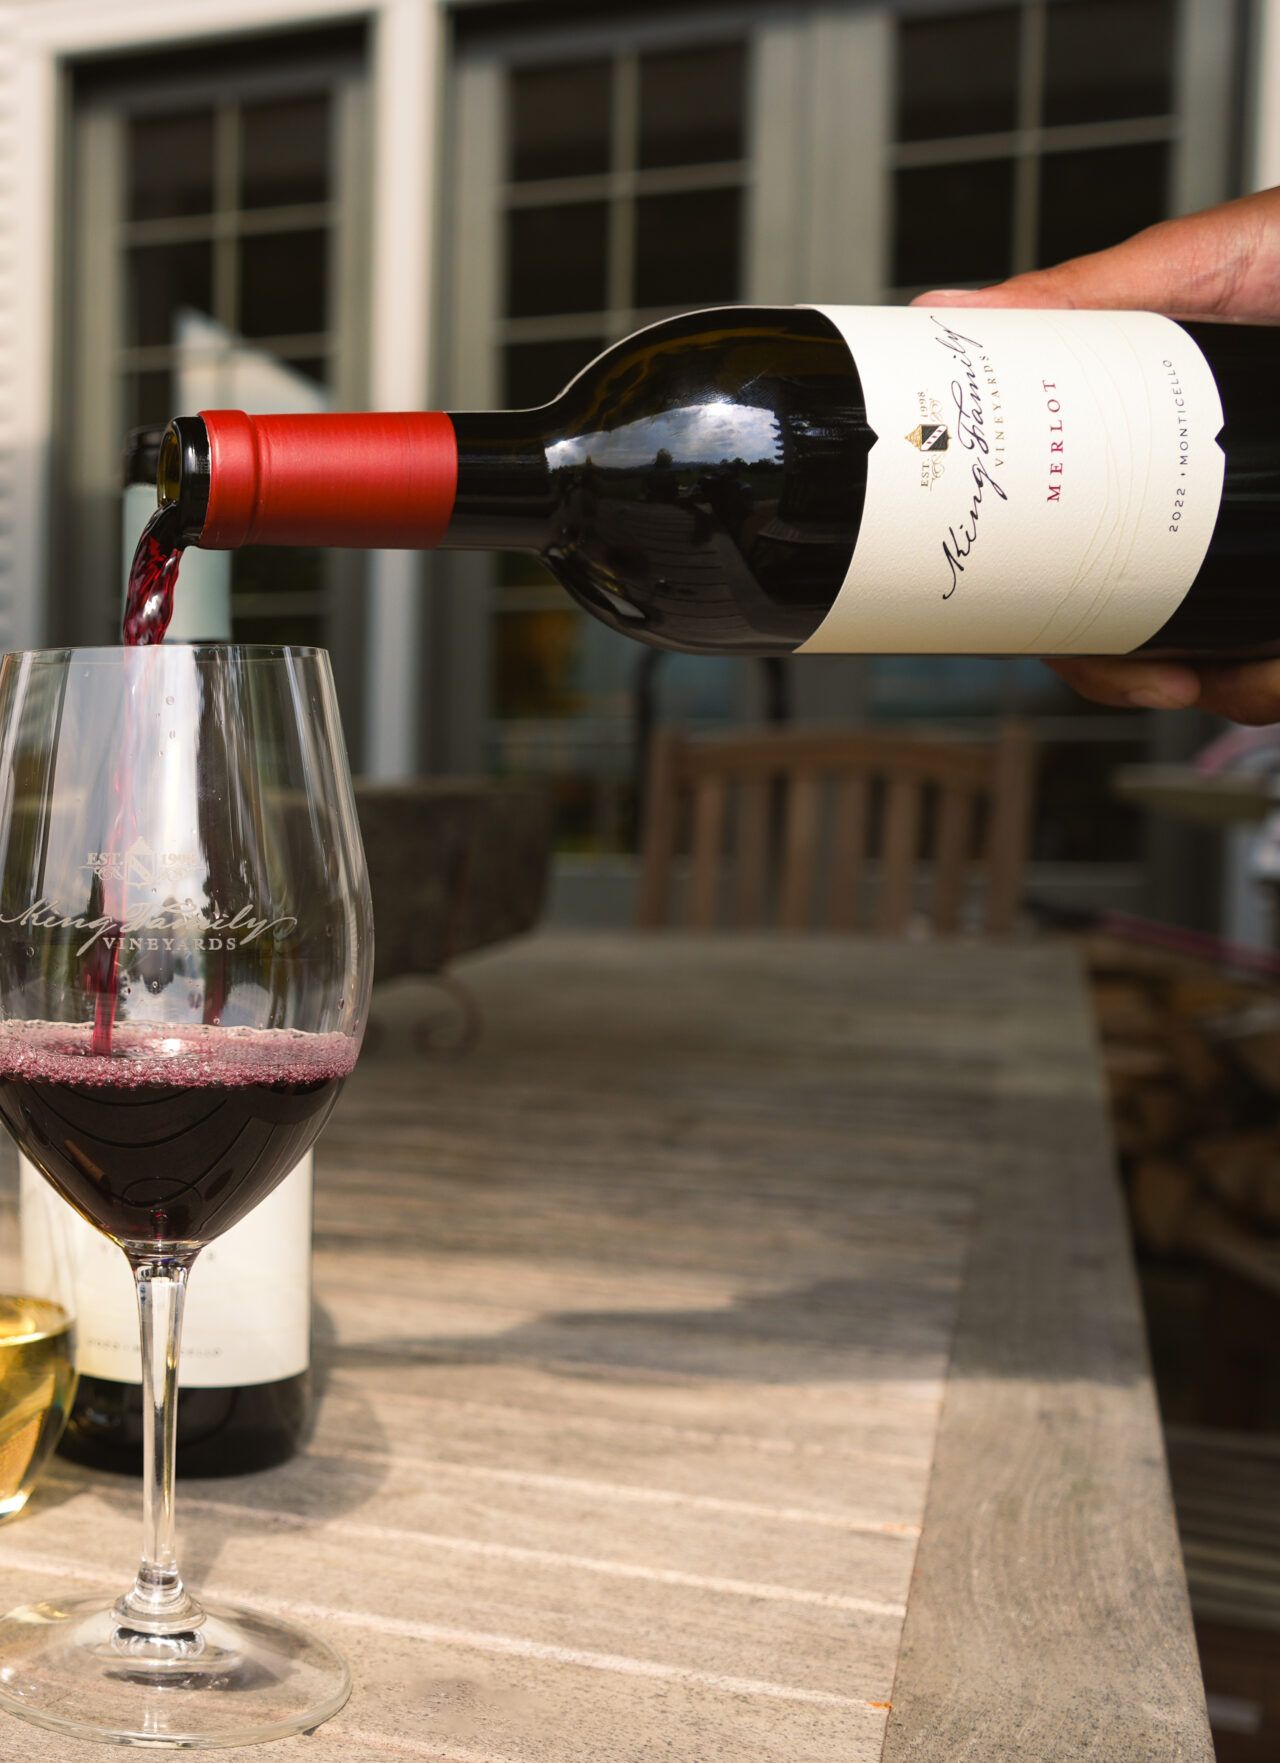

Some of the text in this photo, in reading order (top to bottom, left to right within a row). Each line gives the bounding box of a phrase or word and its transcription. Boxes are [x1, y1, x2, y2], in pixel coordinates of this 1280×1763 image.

[929, 315, 1008, 600] King Family
[978, 355, 1005, 467] VINEYARDS
[1041, 379, 1064, 502] MERLOT
[1162, 359, 1188, 532] 2022 MONTICELLO
[920, 457, 930, 487] EST.
[0, 898, 297, 956] King Family
[102, 937, 237, 951] VINEYARDS
